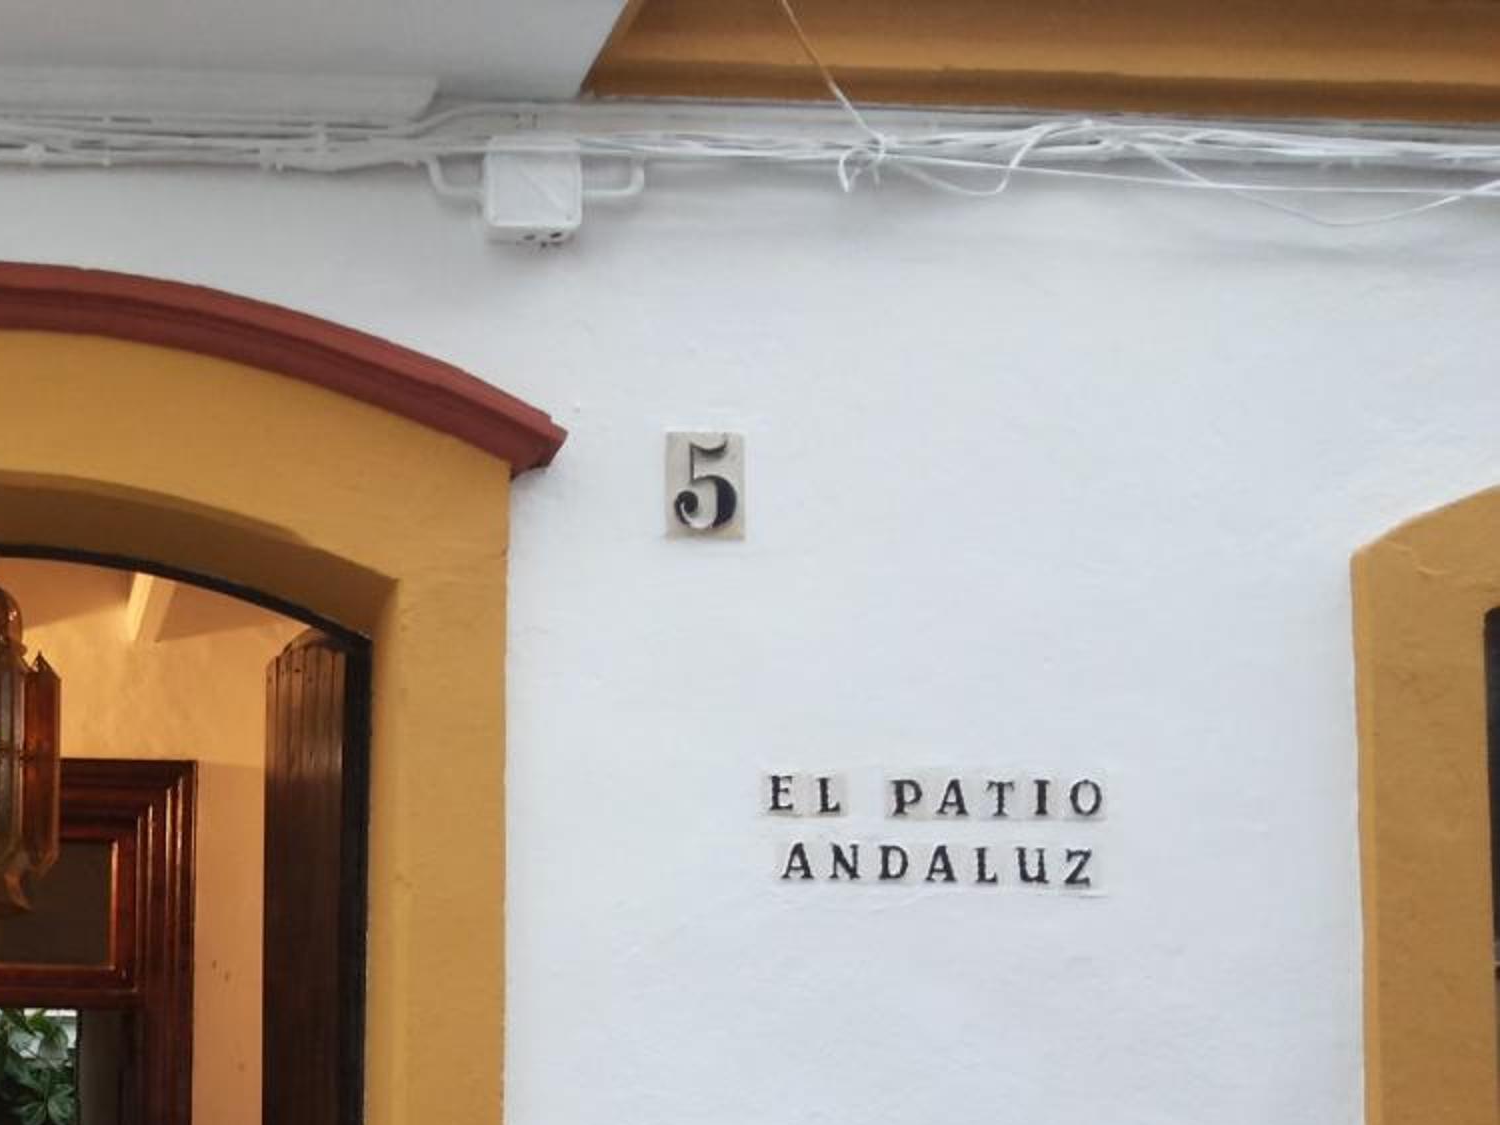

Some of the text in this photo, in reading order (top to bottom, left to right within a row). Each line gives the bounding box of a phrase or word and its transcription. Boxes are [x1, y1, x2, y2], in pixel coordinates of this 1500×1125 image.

[674, 438, 737, 529] 5
[768, 775, 1102, 817] EL PATIO
[781, 842, 1092, 886] ANDALUZ
